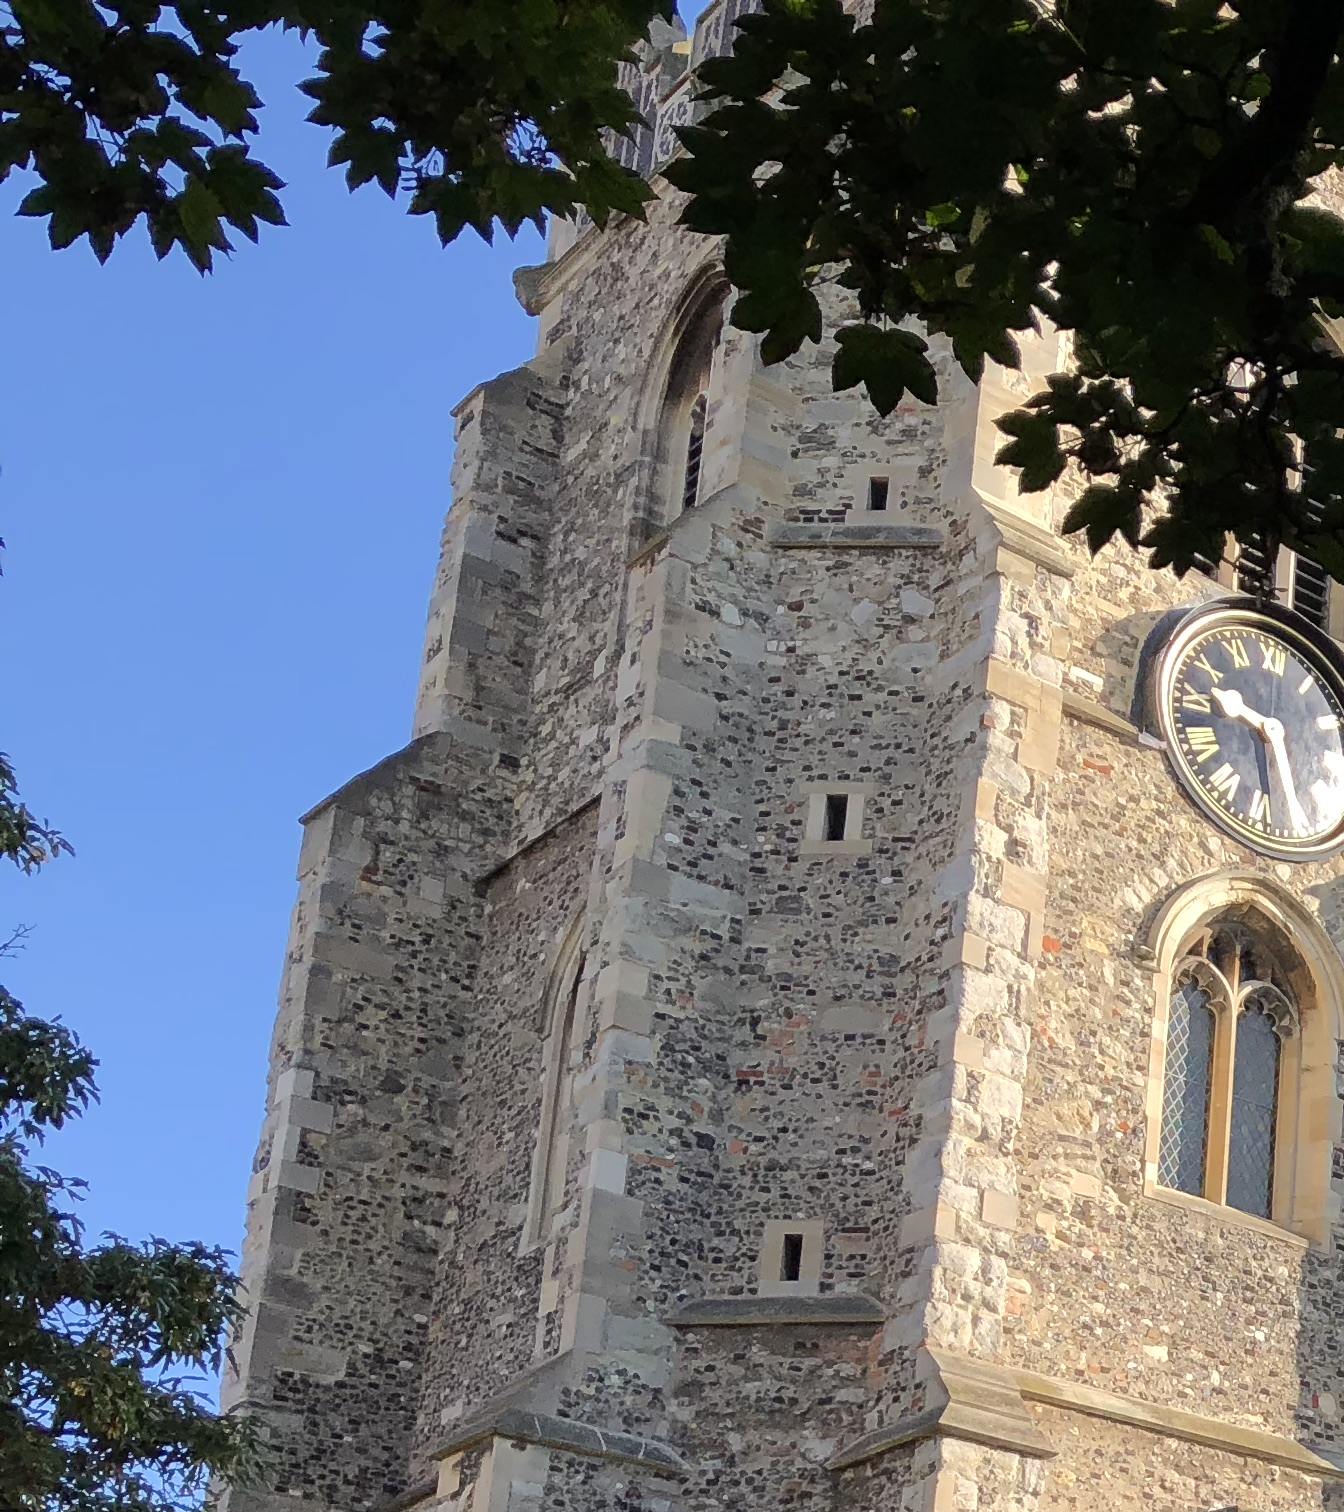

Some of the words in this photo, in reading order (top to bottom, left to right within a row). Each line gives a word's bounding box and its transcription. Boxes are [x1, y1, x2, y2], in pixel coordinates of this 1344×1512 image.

[1193, 653, 1224, 684] X
[1221, 639, 1250, 669] XI
[1259, 642, 1286, 677] XII
[1182, 682, 1212, 713] IX
[1185, 727, 1220, 763] VIII
[1209, 763, 1241, 802] VII
